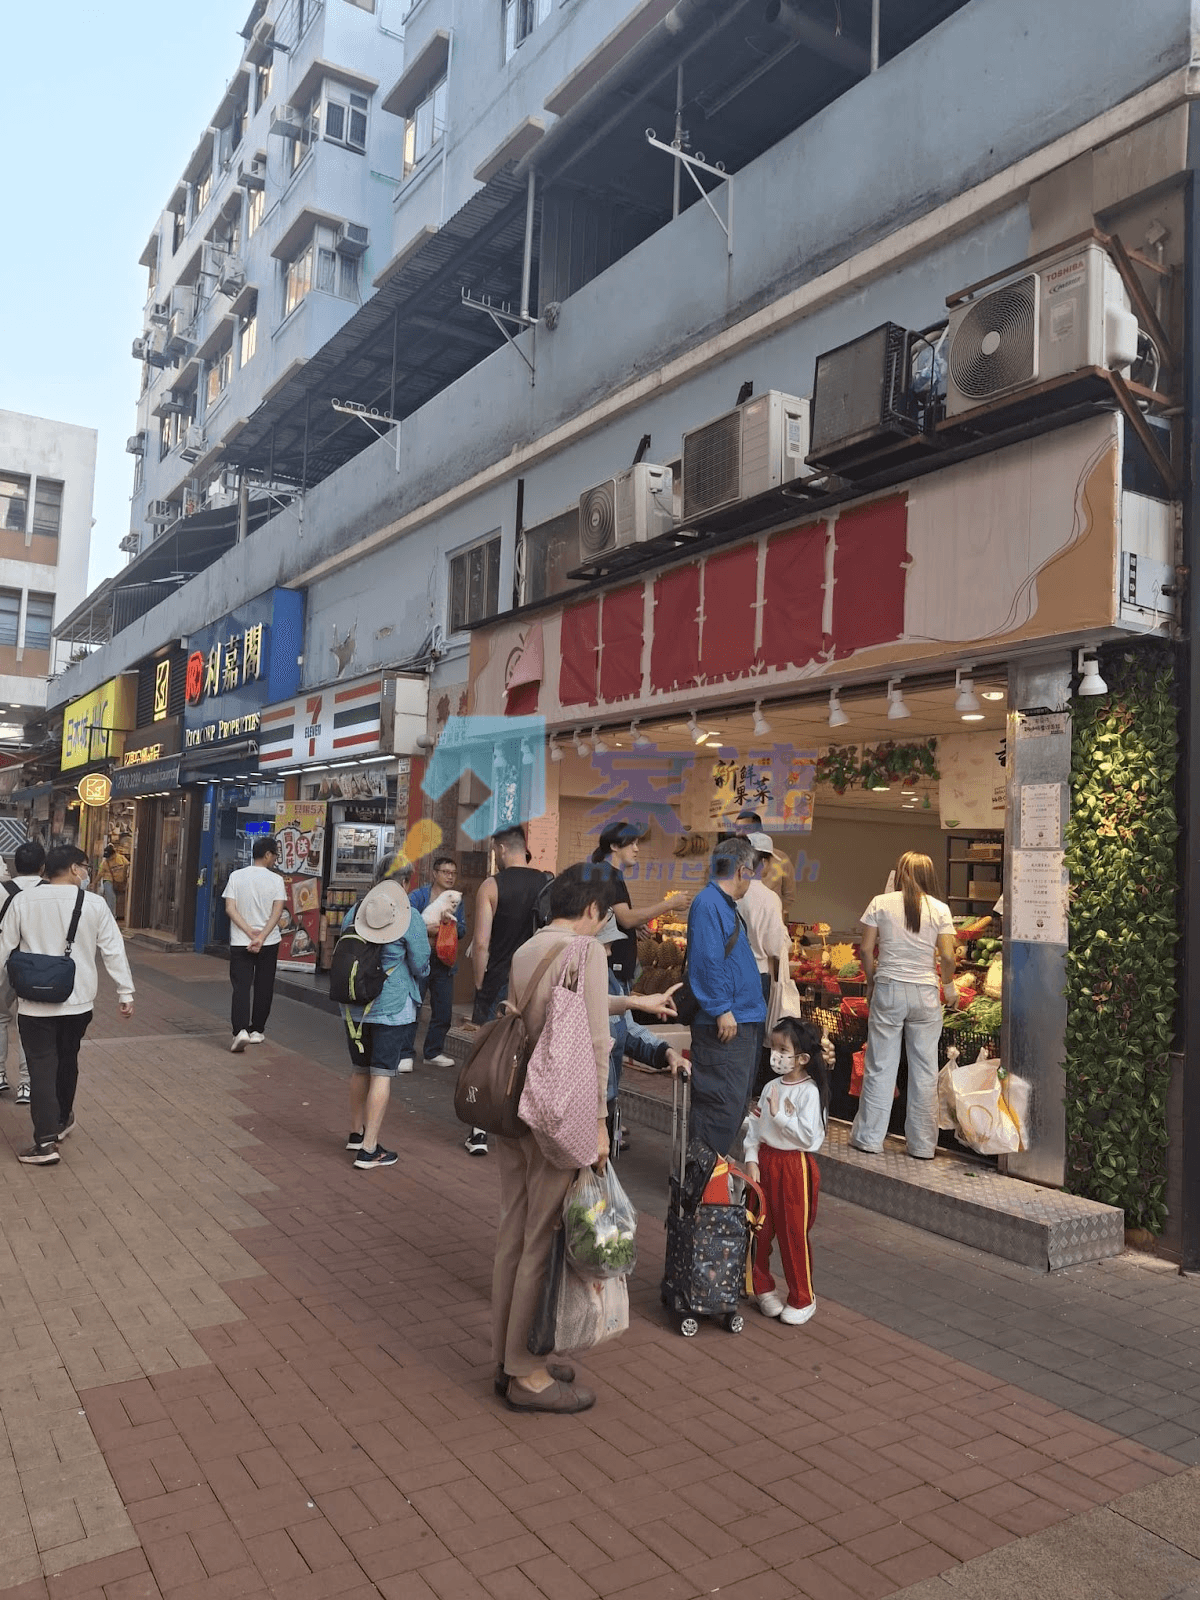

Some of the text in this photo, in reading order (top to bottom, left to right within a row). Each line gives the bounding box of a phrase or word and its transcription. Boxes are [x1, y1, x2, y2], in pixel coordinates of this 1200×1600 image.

[1046, 261, 1084, 282] TOSHIBA
[204, 621, 262, 696] 利嘉閣
[185, 712, 260, 747] RICACORP PROPERTIES
[306, 695, 322, 756] 7
[296, 838, 308, 855] 送
